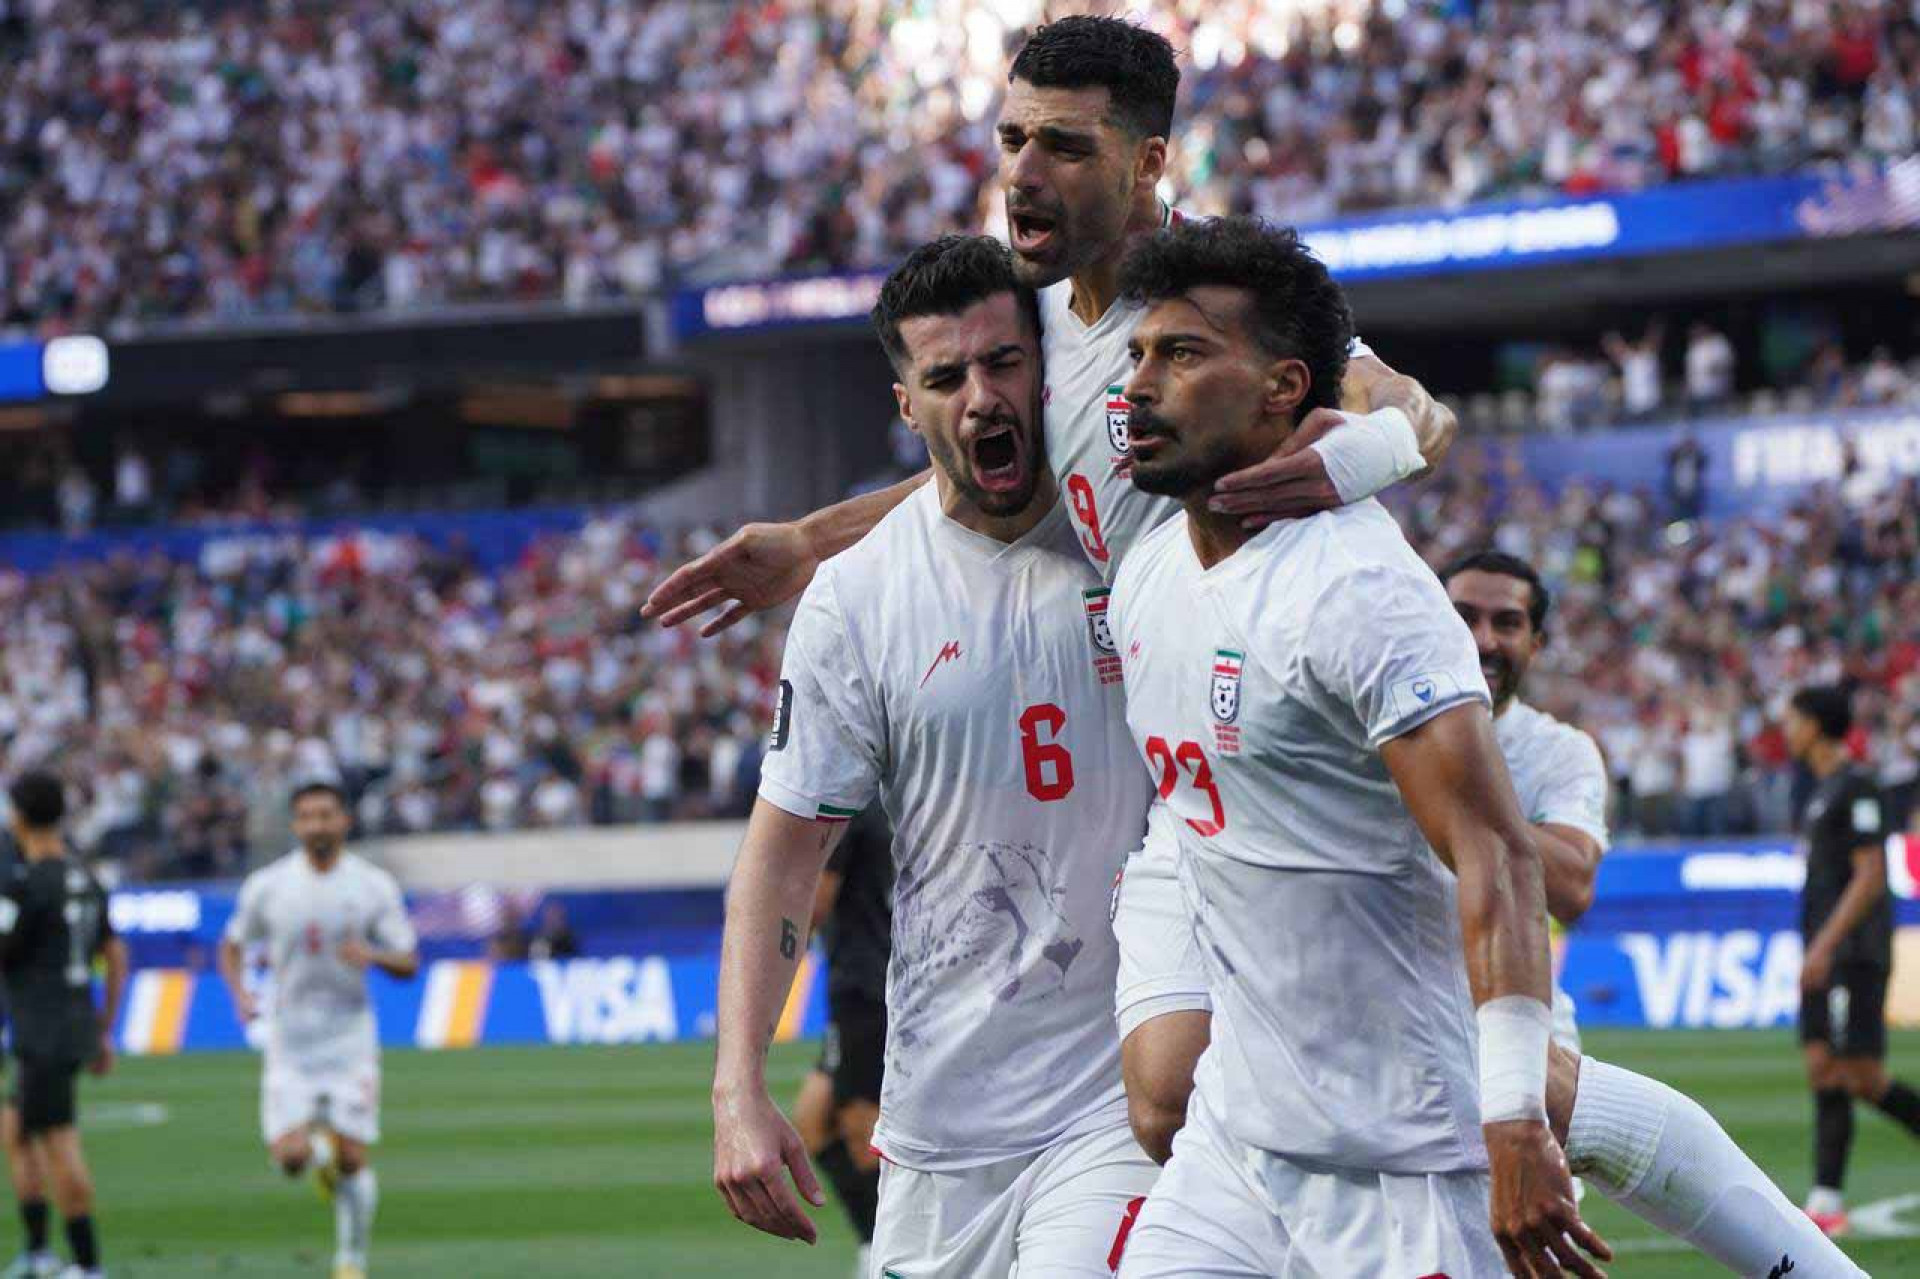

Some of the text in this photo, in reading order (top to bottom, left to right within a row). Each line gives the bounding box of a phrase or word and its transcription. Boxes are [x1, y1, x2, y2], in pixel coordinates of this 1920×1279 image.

[1067, 473, 1110, 563] 9
[1019, 703, 1074, 802] 6
[1145, 735, 1225, 837] 23
[529, 956, 678, 1044] VISA
[1617, 929, 1803, 1029] VISA
